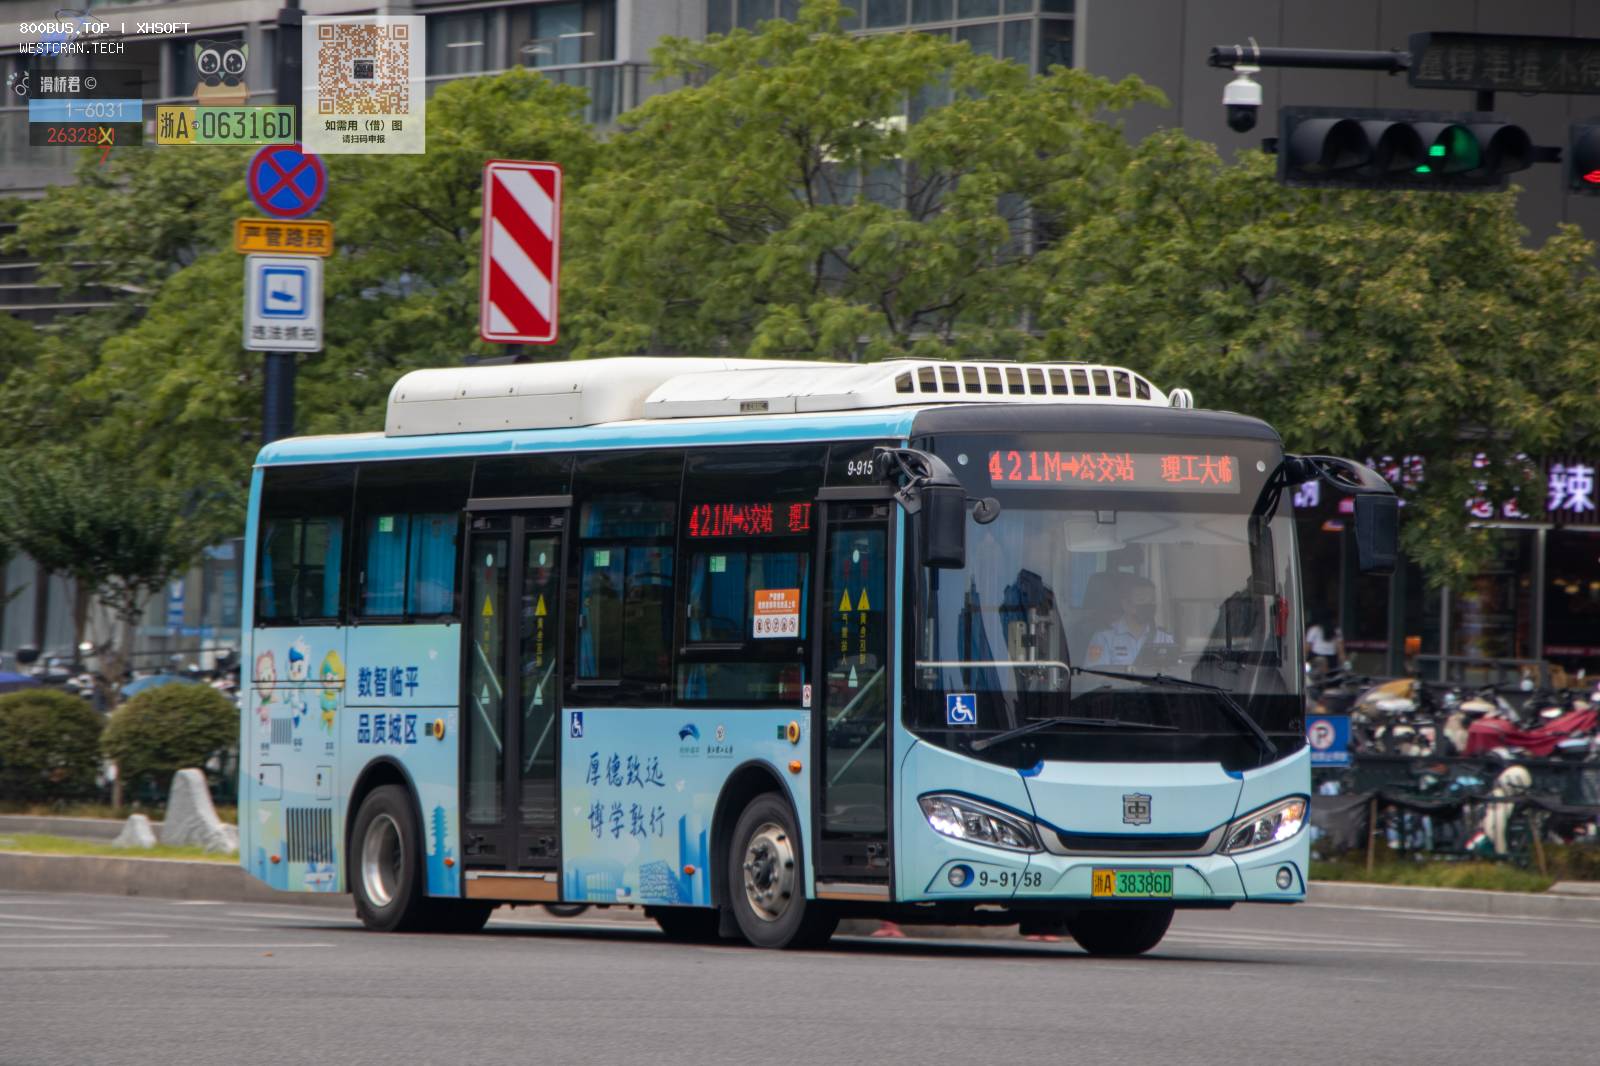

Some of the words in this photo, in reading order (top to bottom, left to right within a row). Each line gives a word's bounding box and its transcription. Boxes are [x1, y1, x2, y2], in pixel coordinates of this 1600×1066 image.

[243, 226, 324, 247] 严管路段
[252, 325, 316, 340] 违法抓拍
[988, 450, 1062, 482] 421M
[1079, 452, 1135, 482] 公交站
[1548, 463, 1595, 513] 辣
[689, 503, 734, 536] 421M
[738, 502, 773, 535] 公交站
[358, 665, 419, 697] 数智临平
[357, 713, 417, 744] 品质城区
[586, 751, 666, 789] 厚德致远
[587, 800, 665, 839] 博学敦行
[979, 871, 1042, 887] 9-9158
[1119, 873, 1172, 893] 38386D
